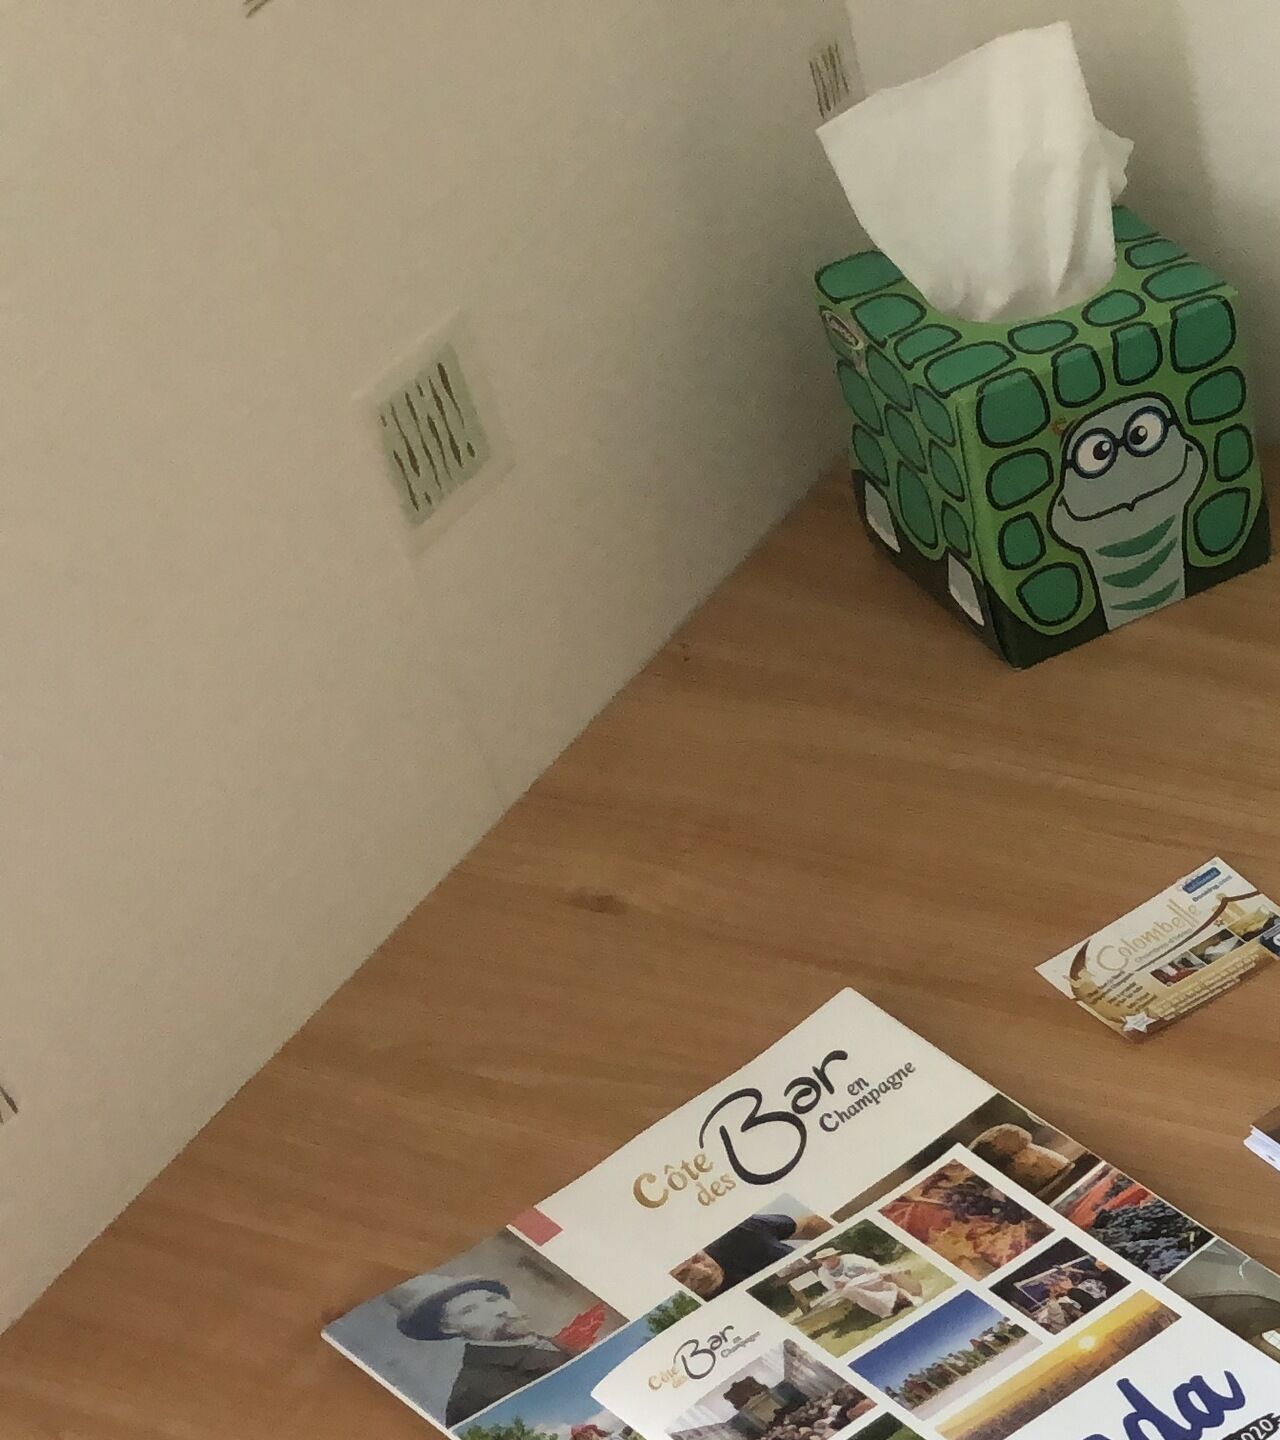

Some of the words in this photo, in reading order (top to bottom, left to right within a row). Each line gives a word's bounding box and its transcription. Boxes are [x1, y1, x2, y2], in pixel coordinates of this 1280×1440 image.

[1096, 898, 1199, 972] Colombelle
[818, 1060, 916, 1132] Champagne
[847, 1076, 870, 1097] en
[699, 1050, 848, 1185] Bar
[633, 1153, 713, 1208] Côte
[697, 1172, 737, 1207] des
[673, 1325, 735, 1379] Bar
